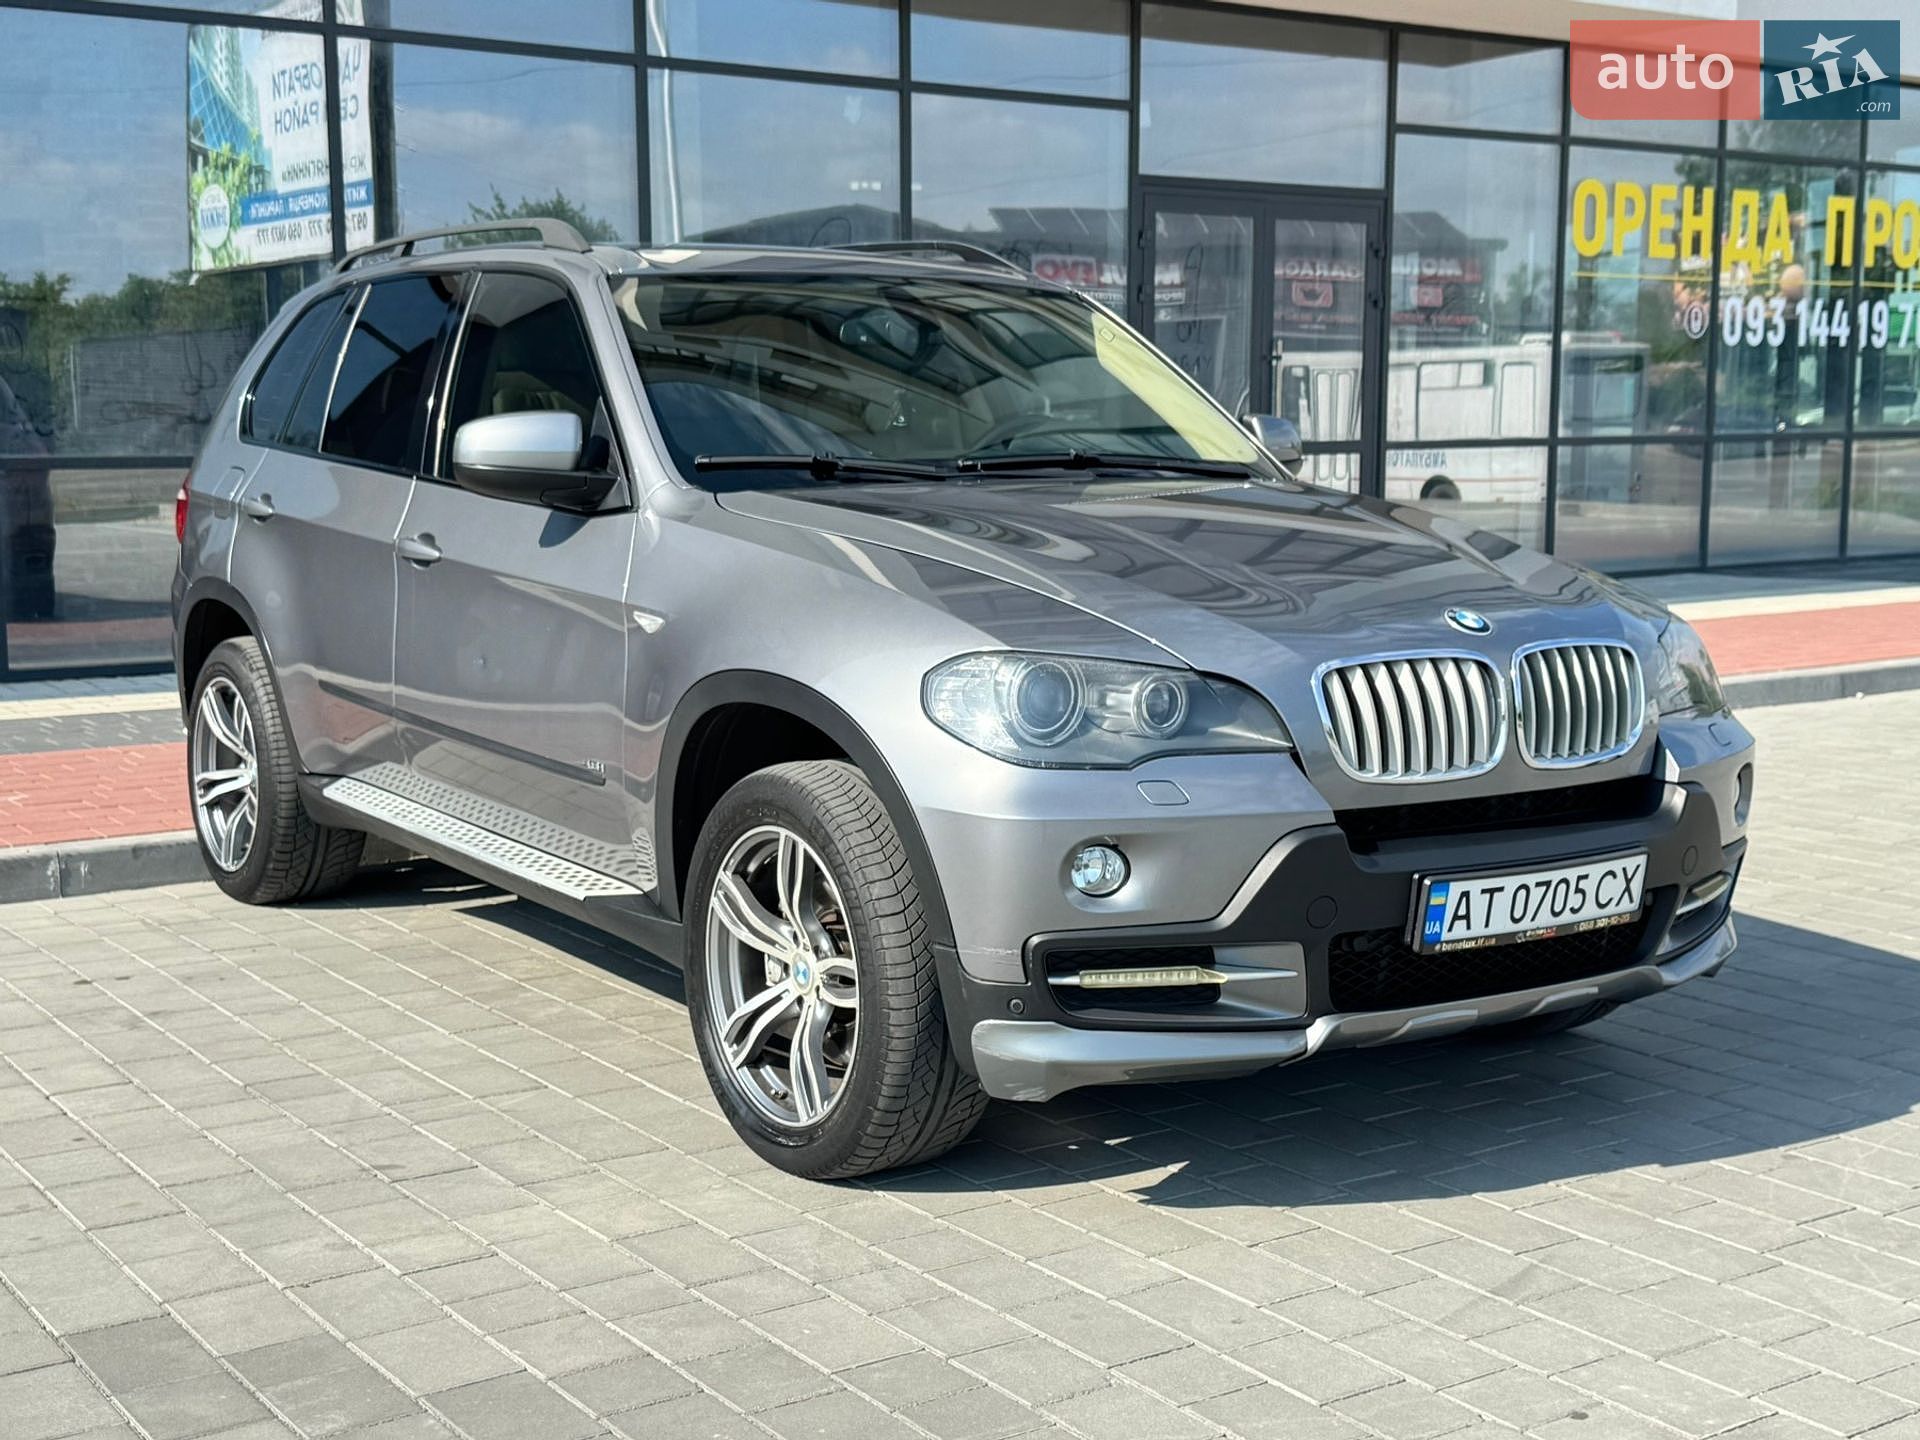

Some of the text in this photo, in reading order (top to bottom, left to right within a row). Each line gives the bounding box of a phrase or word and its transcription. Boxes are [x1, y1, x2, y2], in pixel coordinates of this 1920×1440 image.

[1572, 179, 1920, 275] ОРЕНДА ПРО
[1722, 295, 1920, 350] 093 144 19 7
[1425, 920, 1441, 935] UA
[1447, 864, 1641, 934] AT 0705 CX
